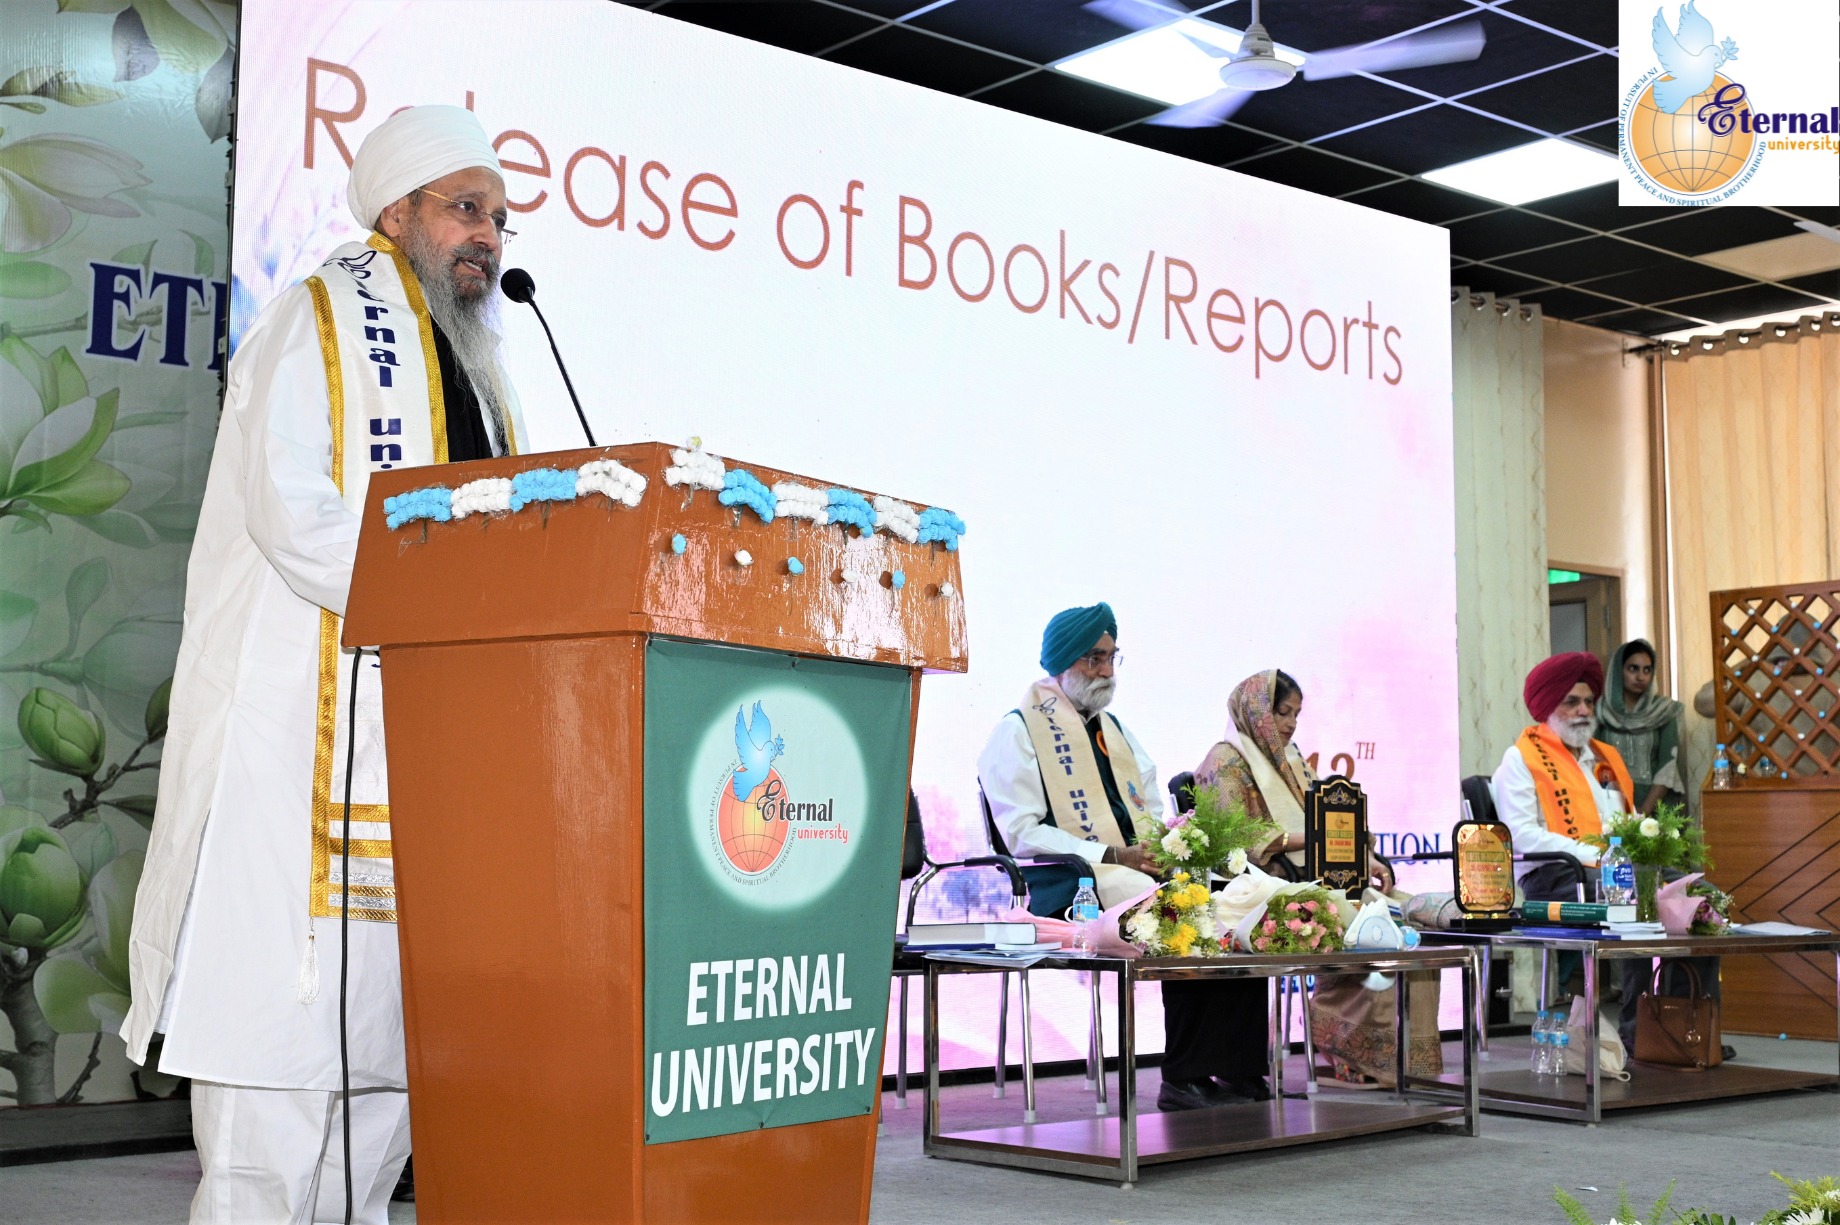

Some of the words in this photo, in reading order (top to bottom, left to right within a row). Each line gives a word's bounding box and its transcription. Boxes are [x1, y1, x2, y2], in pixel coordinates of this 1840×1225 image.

[303, 57, 739, 251] Rease
[776, 179, 864, 277] of
[898, 194, 1403, 386] Books/Reports
[369, 418, 402, 469] un
[1032, 697, 1074, 776] Eternal
[757, 780, 833, 821] Eternal
[798, 823, 848, 844] university
[686, 952, 852, 1027] ETERNAL
[651, 1027, 876, 1117] UNIVERSITY
